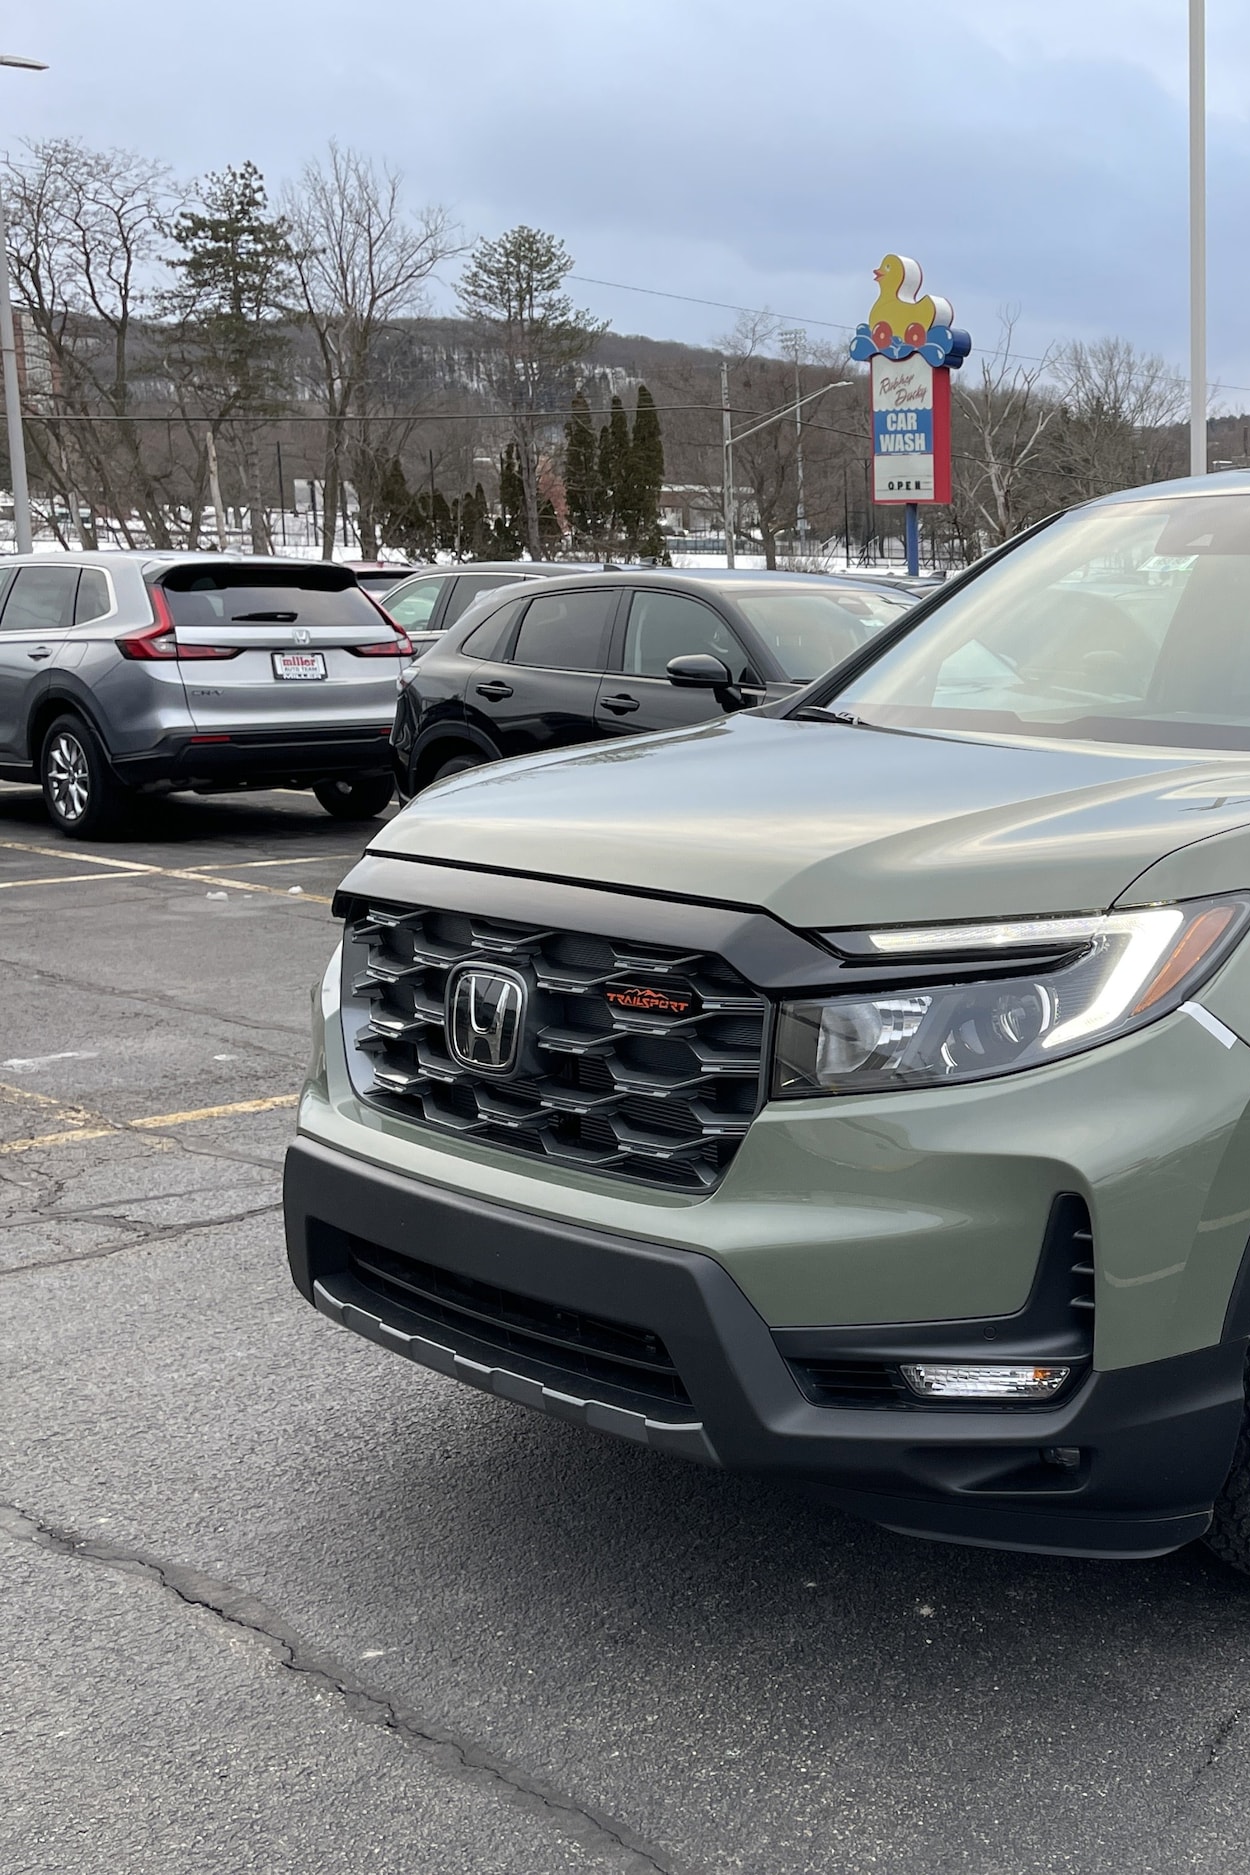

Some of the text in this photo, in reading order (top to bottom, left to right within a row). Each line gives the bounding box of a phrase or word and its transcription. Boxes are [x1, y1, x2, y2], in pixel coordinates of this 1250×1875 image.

[895, 384, 927, 407] Ducky
[886, 412, 918, 431] CAR
[879, 433, 926, 453] WASH
[887, 480, 921, 491] OPEN
[282, 656, 315, 666] miller
[606, 992, 689, 1013] TRAILSPORT
